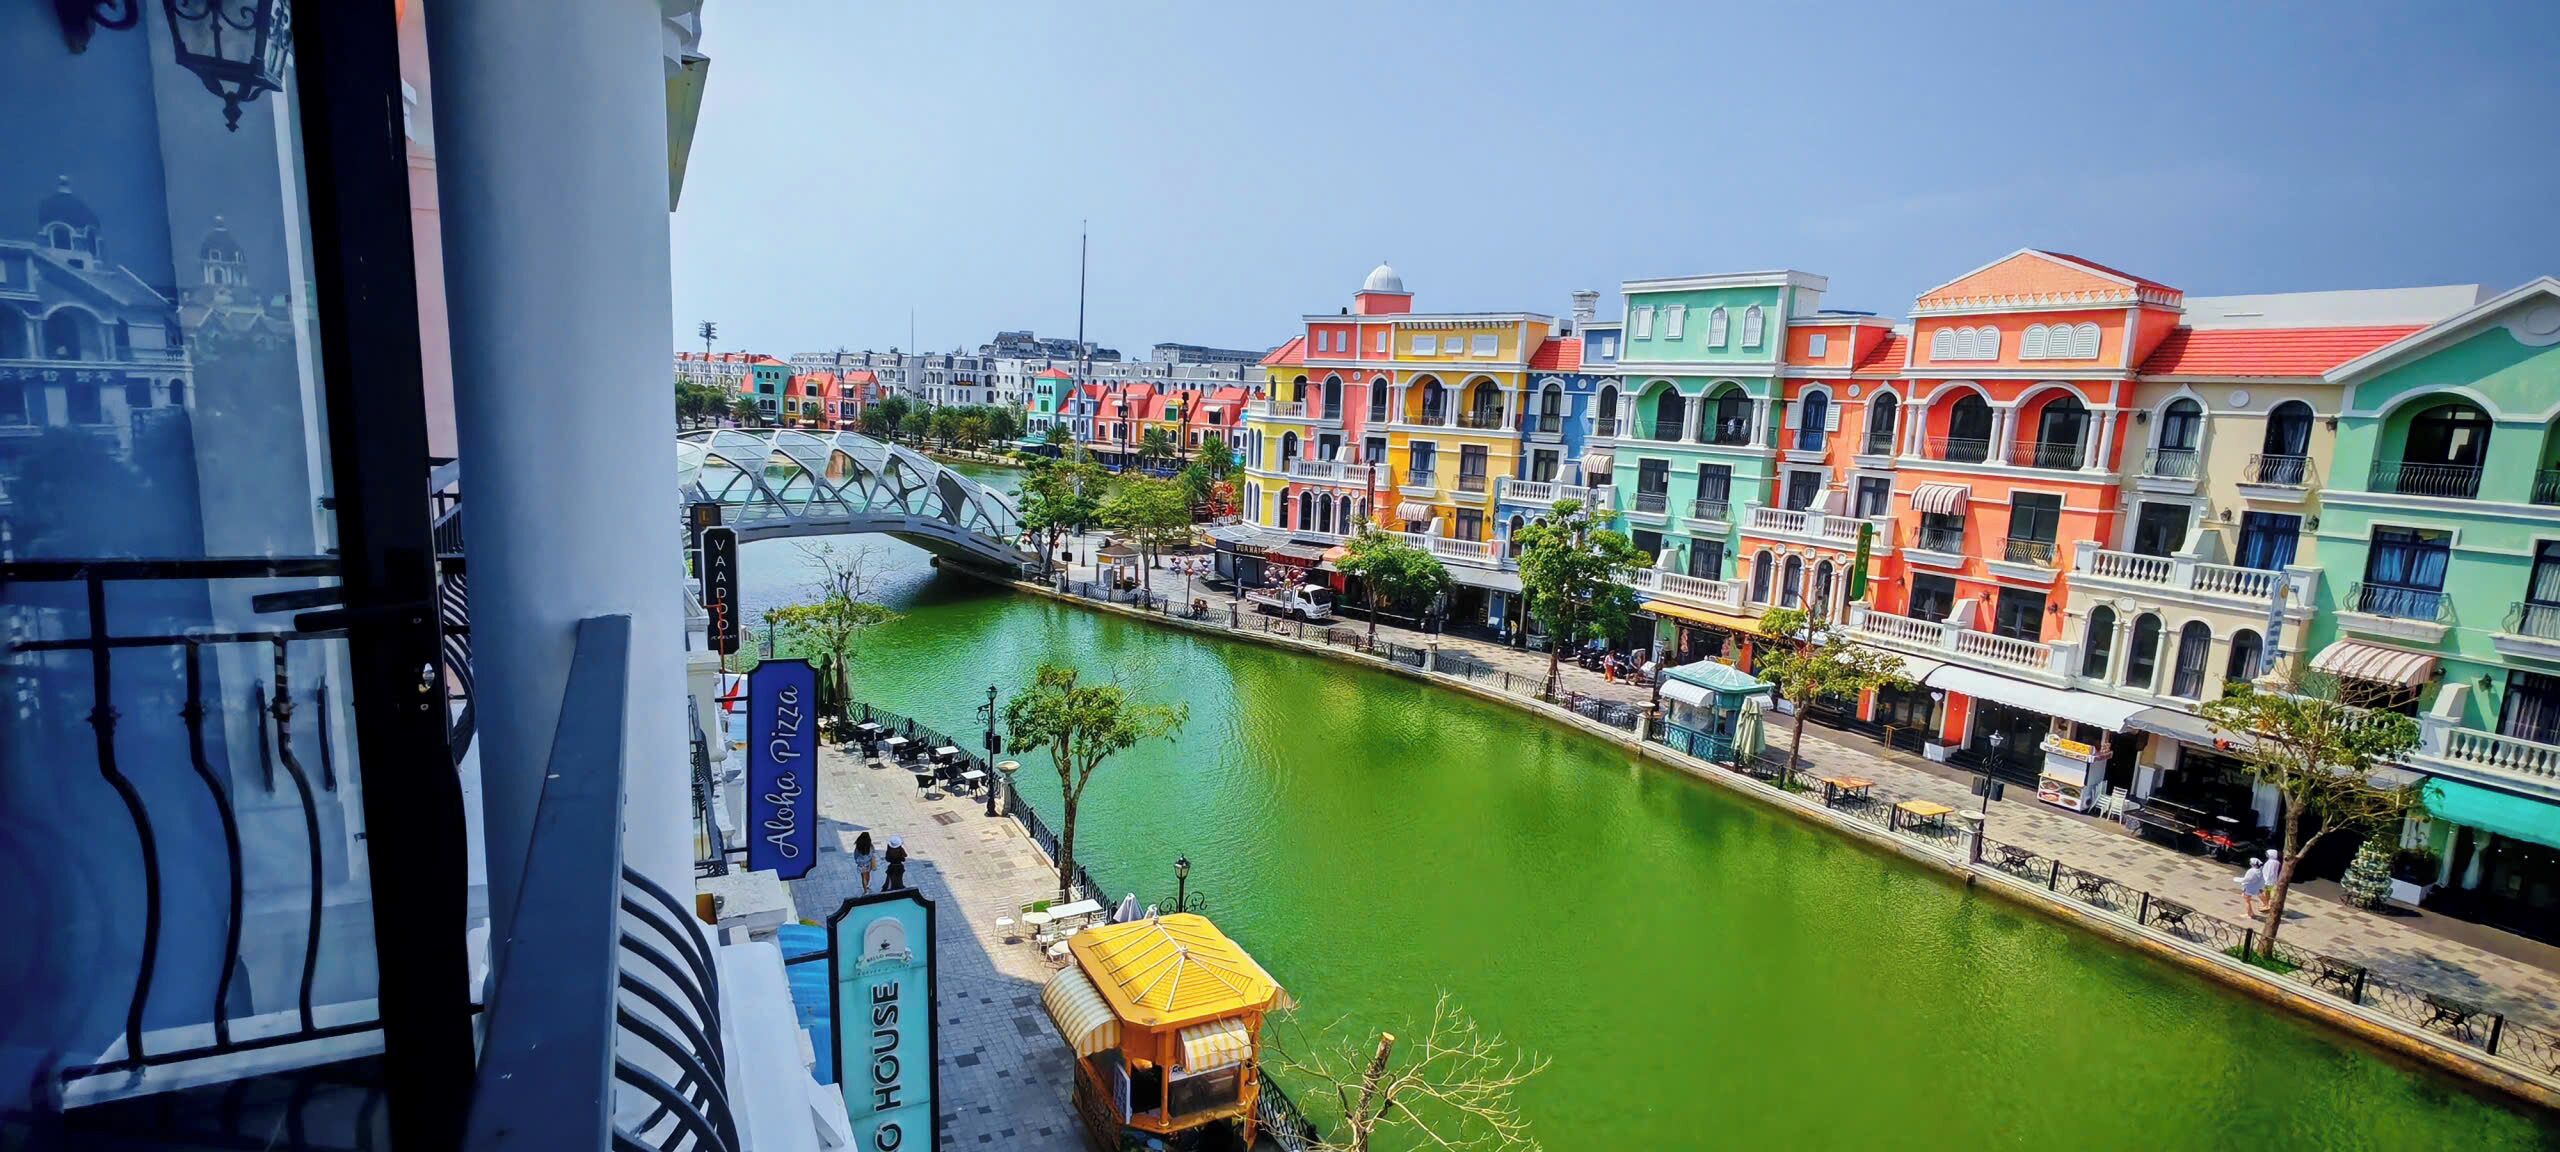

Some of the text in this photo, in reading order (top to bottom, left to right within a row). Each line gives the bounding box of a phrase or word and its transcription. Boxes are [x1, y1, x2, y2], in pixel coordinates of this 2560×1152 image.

[714, 539, 729, 631] VAADOO
[764, 685, 803, 859] Aloha Pizza
[871, 980, 902, 1113] HOUSE
